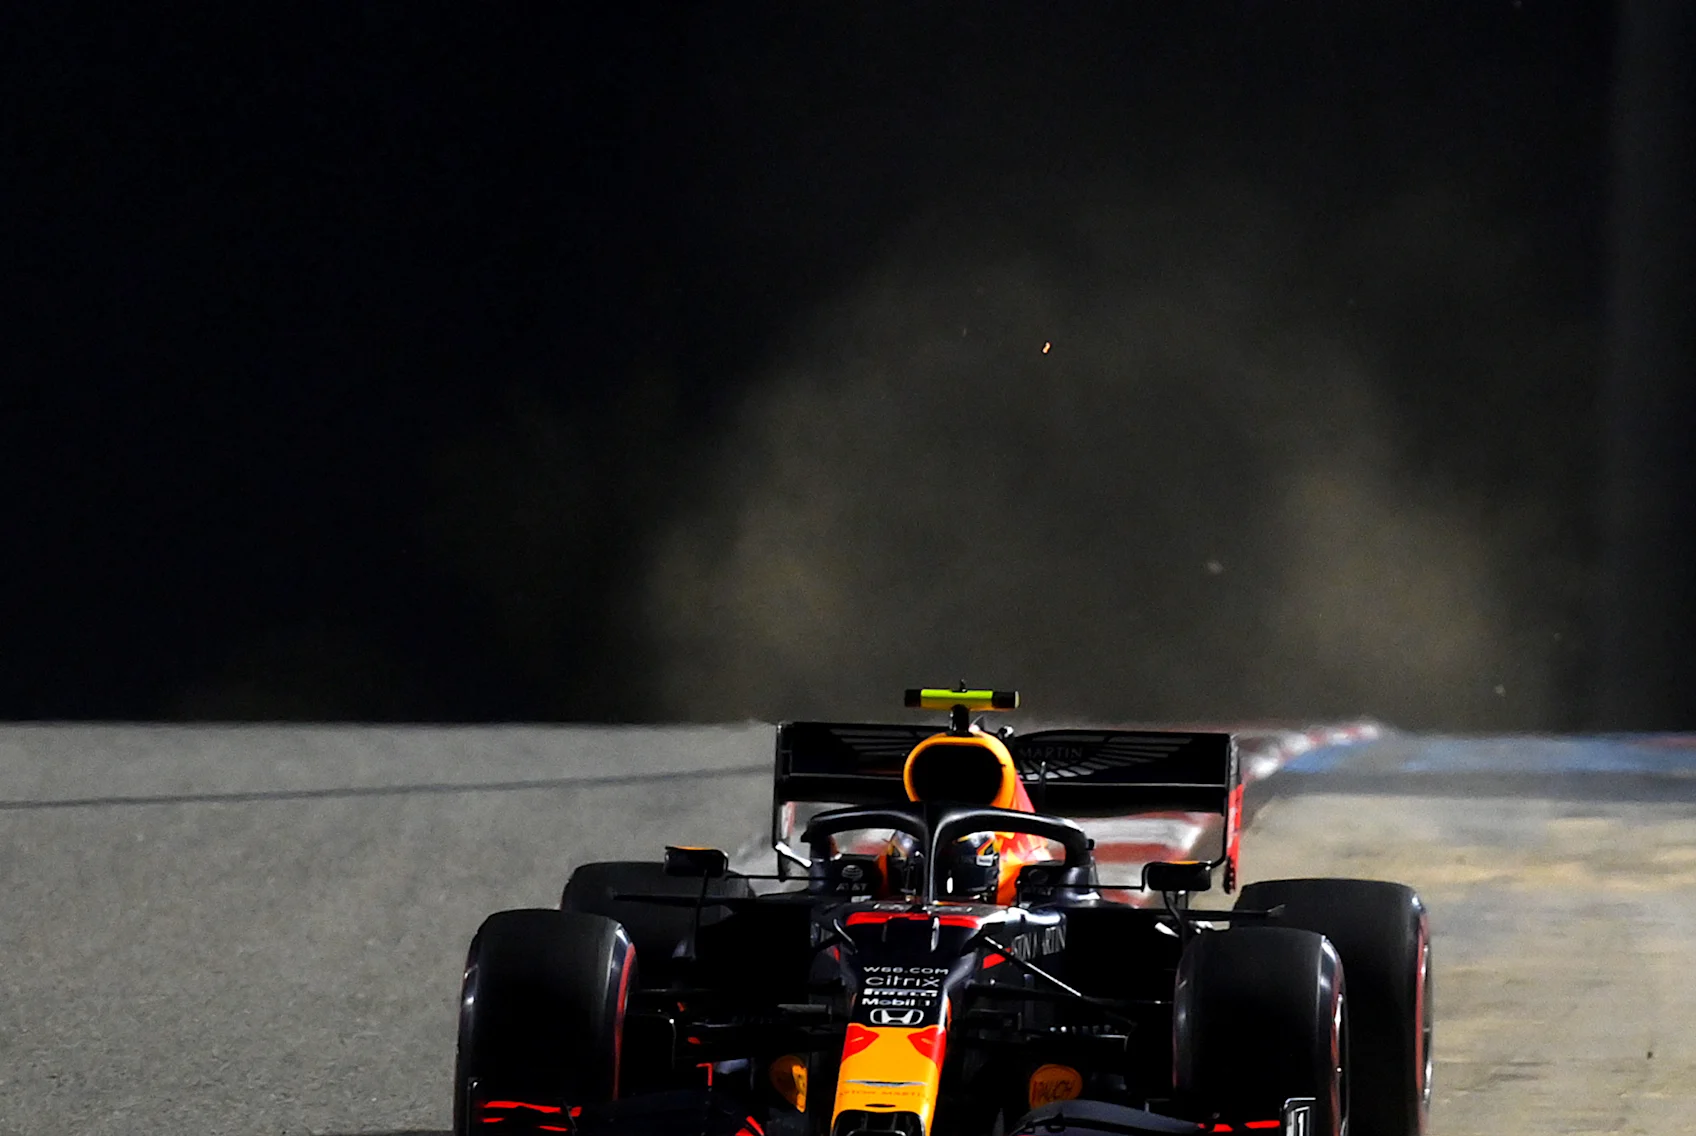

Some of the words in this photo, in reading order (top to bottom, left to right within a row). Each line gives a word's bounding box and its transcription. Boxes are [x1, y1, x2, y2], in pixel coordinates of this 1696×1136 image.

[1018, 745, 1084, 759] MARTIN
[865, 975, 940, 987] citrix
[862, 998, 915, 1006] Mobil
